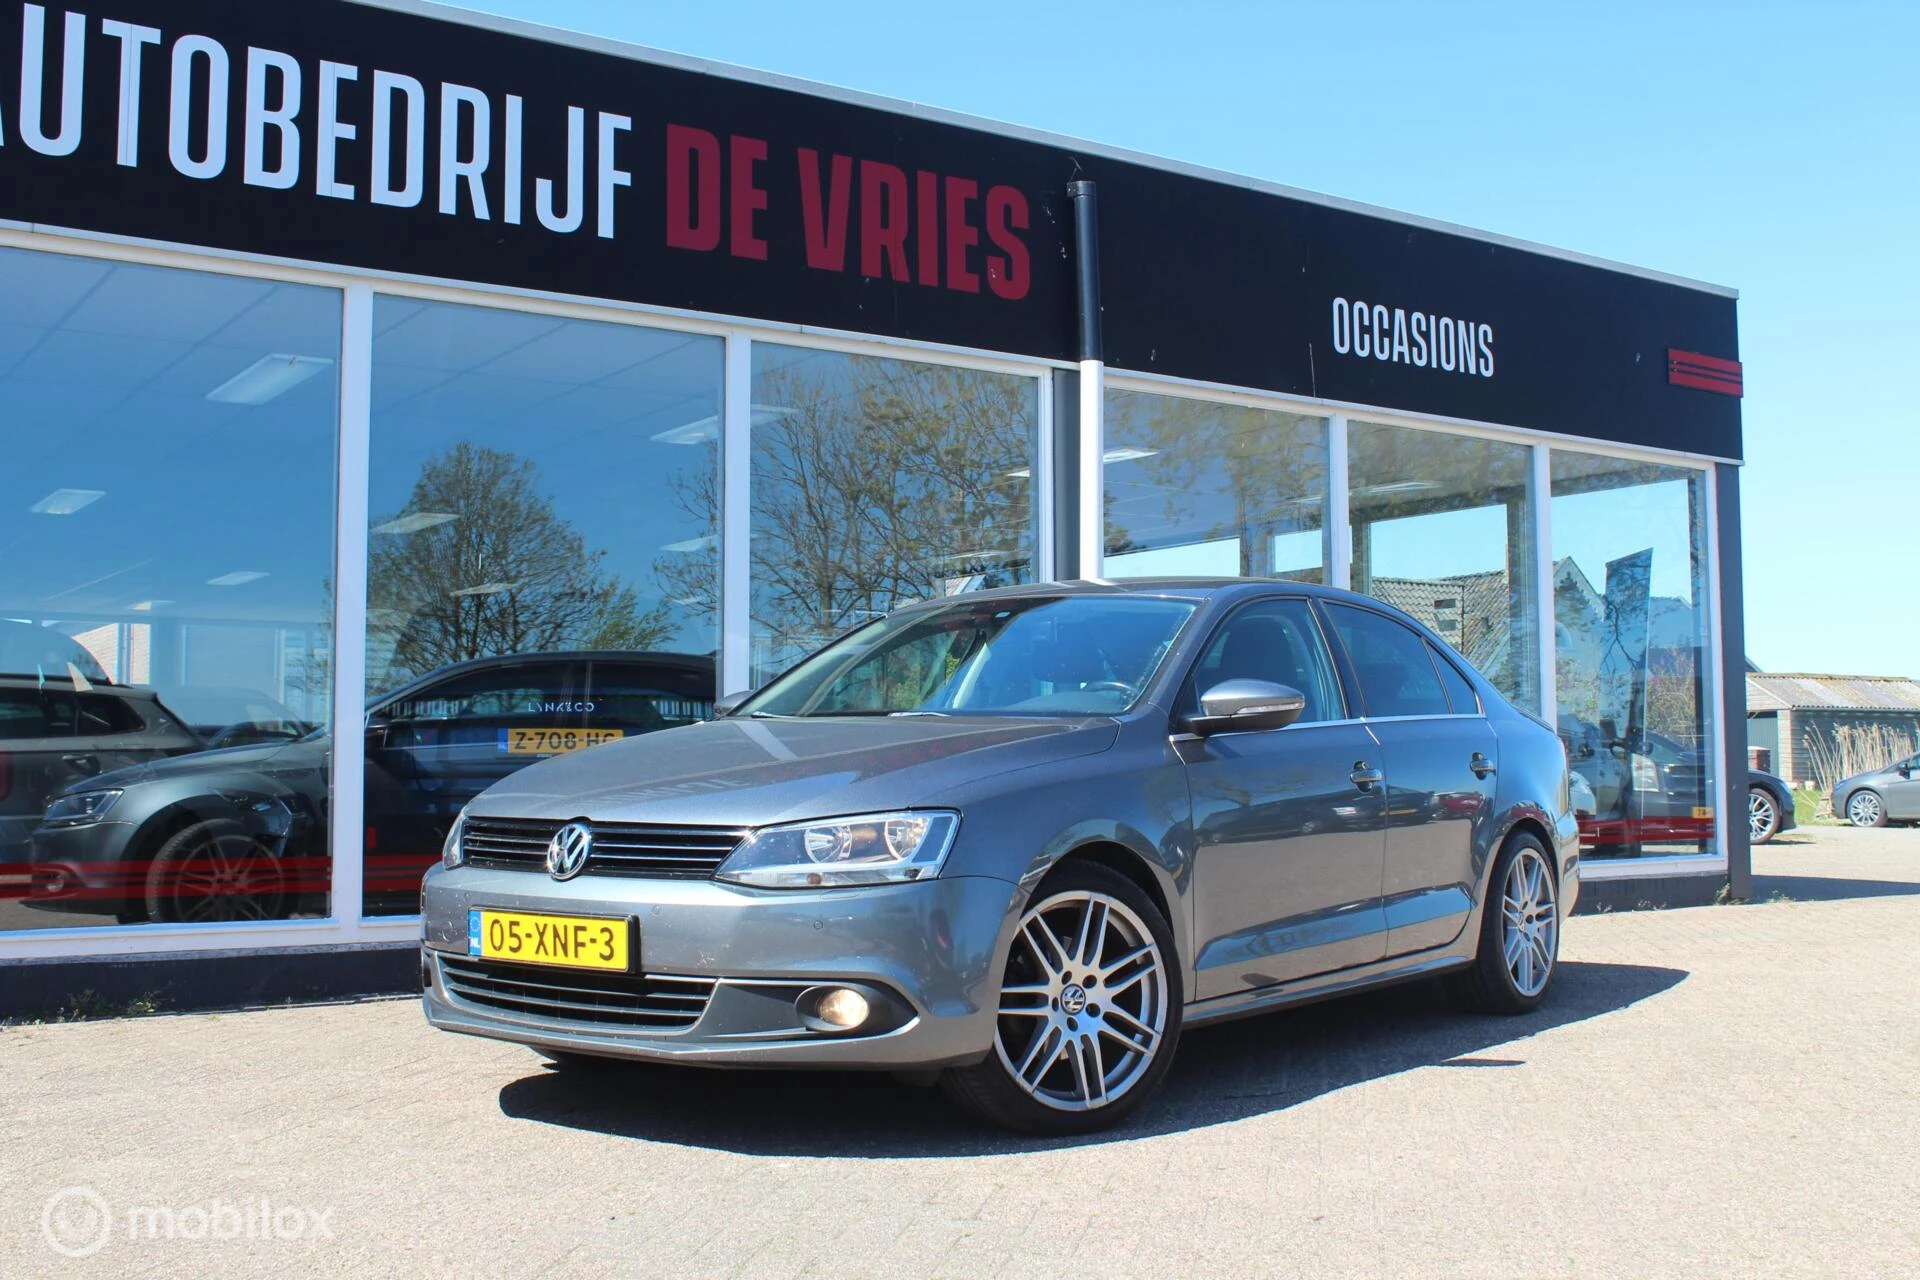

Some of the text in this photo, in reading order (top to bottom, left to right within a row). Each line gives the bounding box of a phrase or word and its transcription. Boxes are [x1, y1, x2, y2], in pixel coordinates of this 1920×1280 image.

[0, 3, 1031, 300] UTOBEDRIJF DE VRIES
[1332, 297, 1494, 378] OCCASIONS
[490, 919, 615, 961] 05-XNF-3
